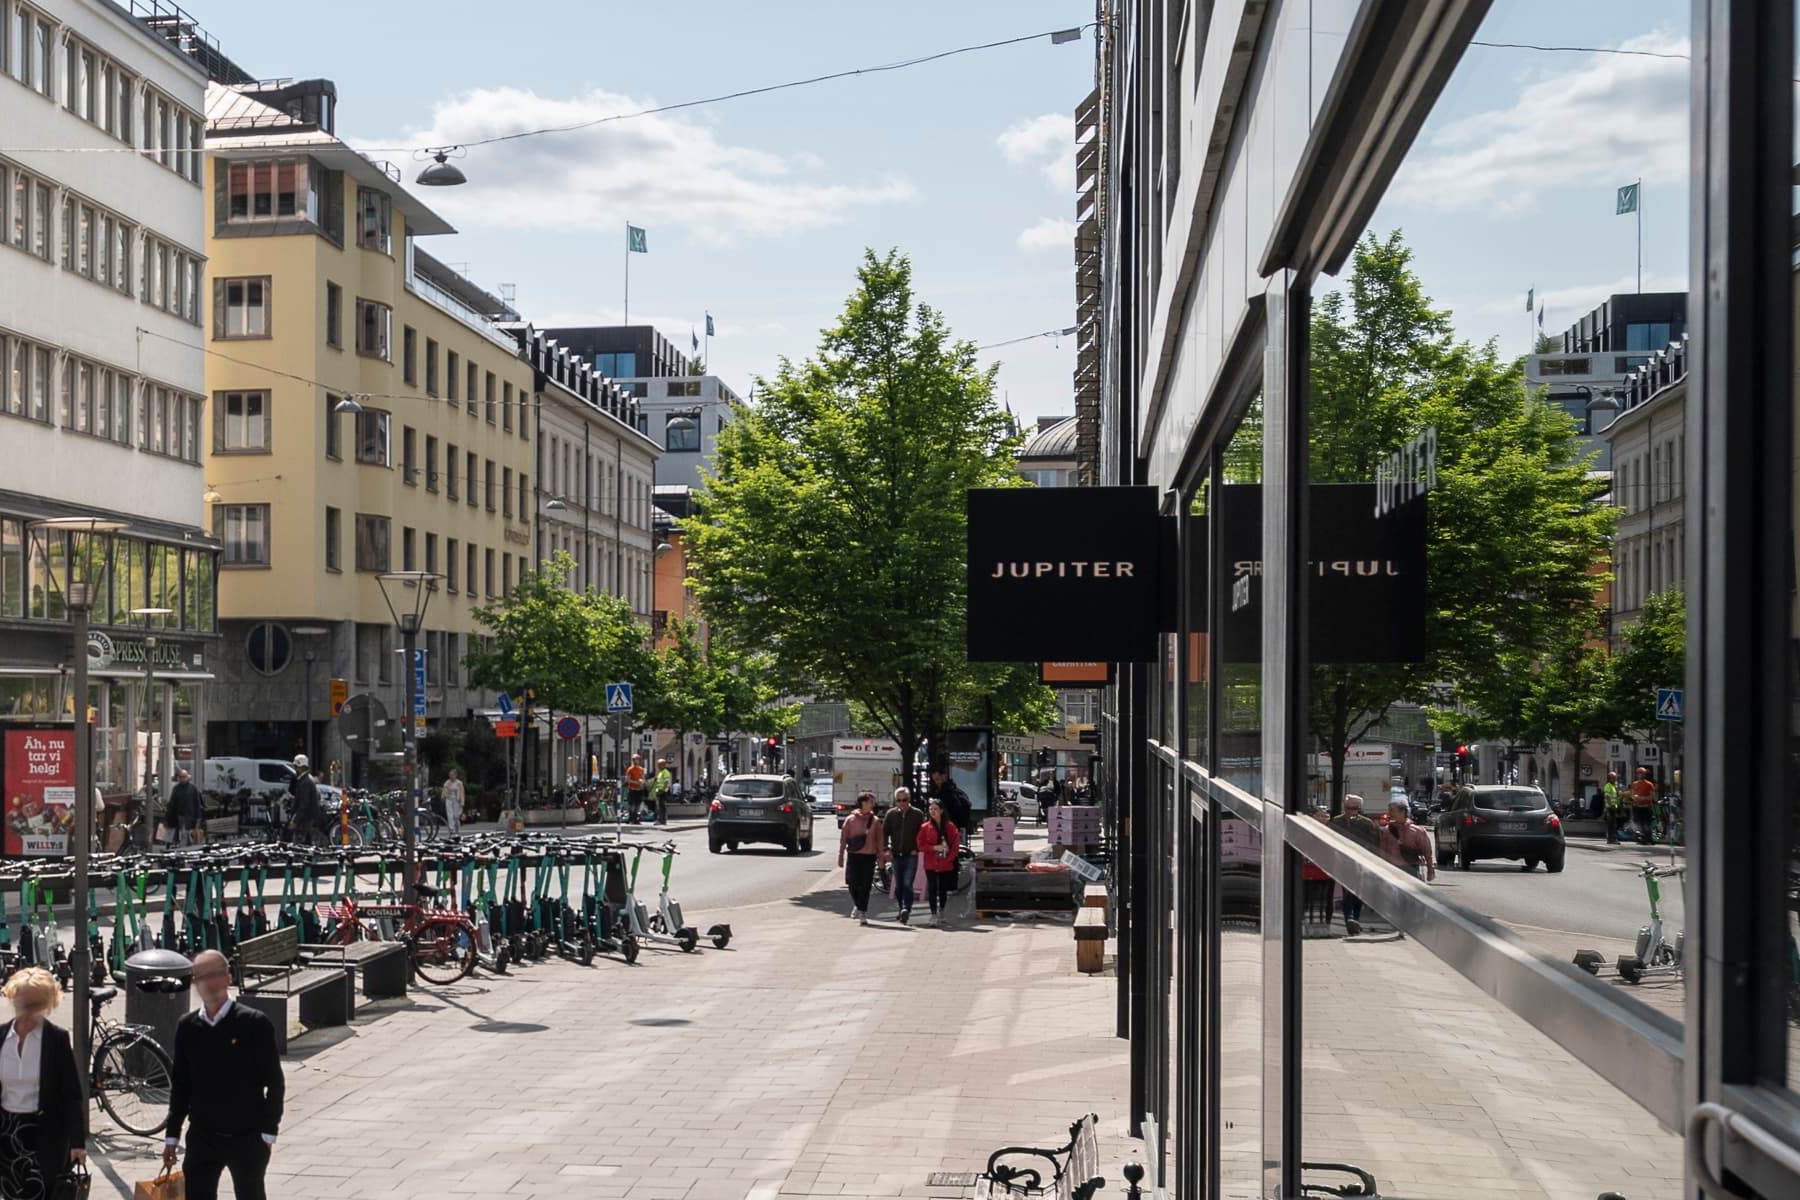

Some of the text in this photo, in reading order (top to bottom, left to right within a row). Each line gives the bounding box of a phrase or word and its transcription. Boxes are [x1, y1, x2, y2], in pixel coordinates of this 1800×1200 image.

[1374, 426, 1436, 519] JUPITER
[991, 561, 1136, 578] JUPITER
[23, 736, 66, 751] Äh, nu
[28, 749, 61, 761] tar vi
[29, 762, 61, 776] helg!
